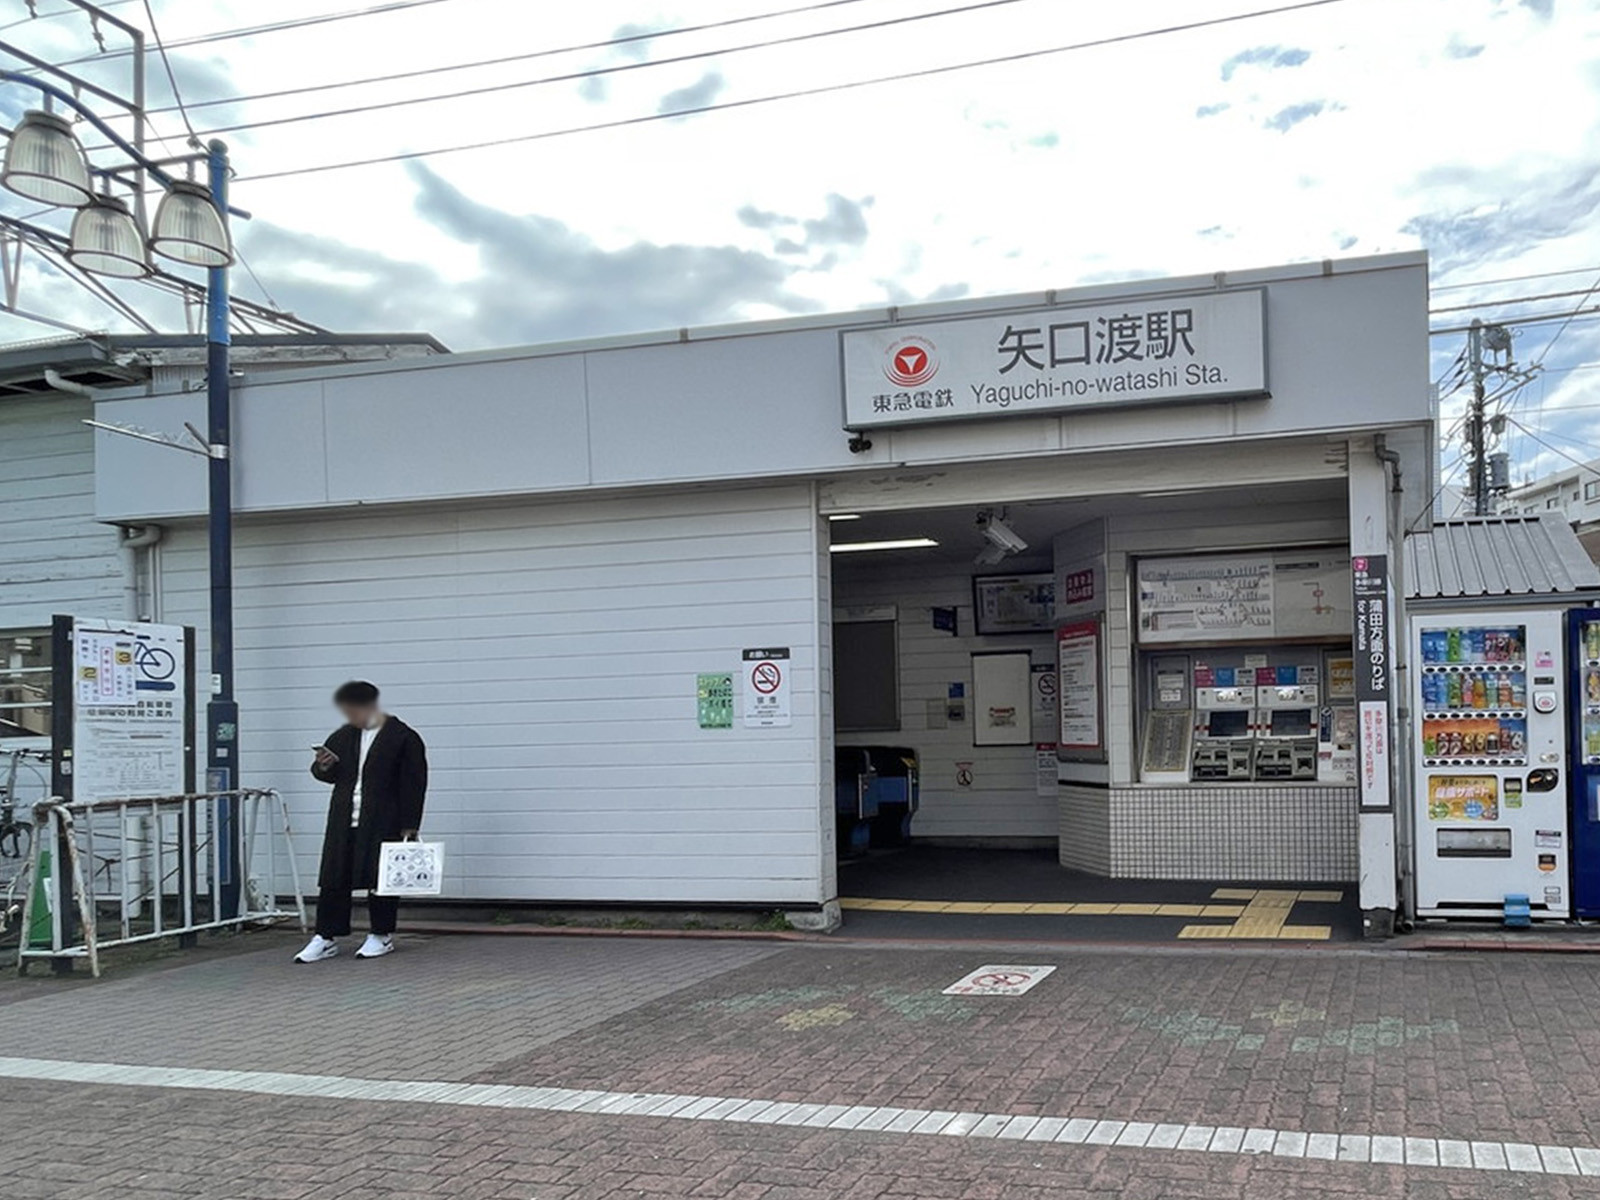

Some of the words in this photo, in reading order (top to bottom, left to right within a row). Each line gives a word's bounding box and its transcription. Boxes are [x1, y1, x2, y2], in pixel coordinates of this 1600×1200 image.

[998, 308, 1196, 375] 矢口渡駅
[872, 388, 954, 413] 東急電鉄
[970, 365, 1178, 408] Yaguchi-no-watashi
[1185, 363, 1228, 386] Sta.
